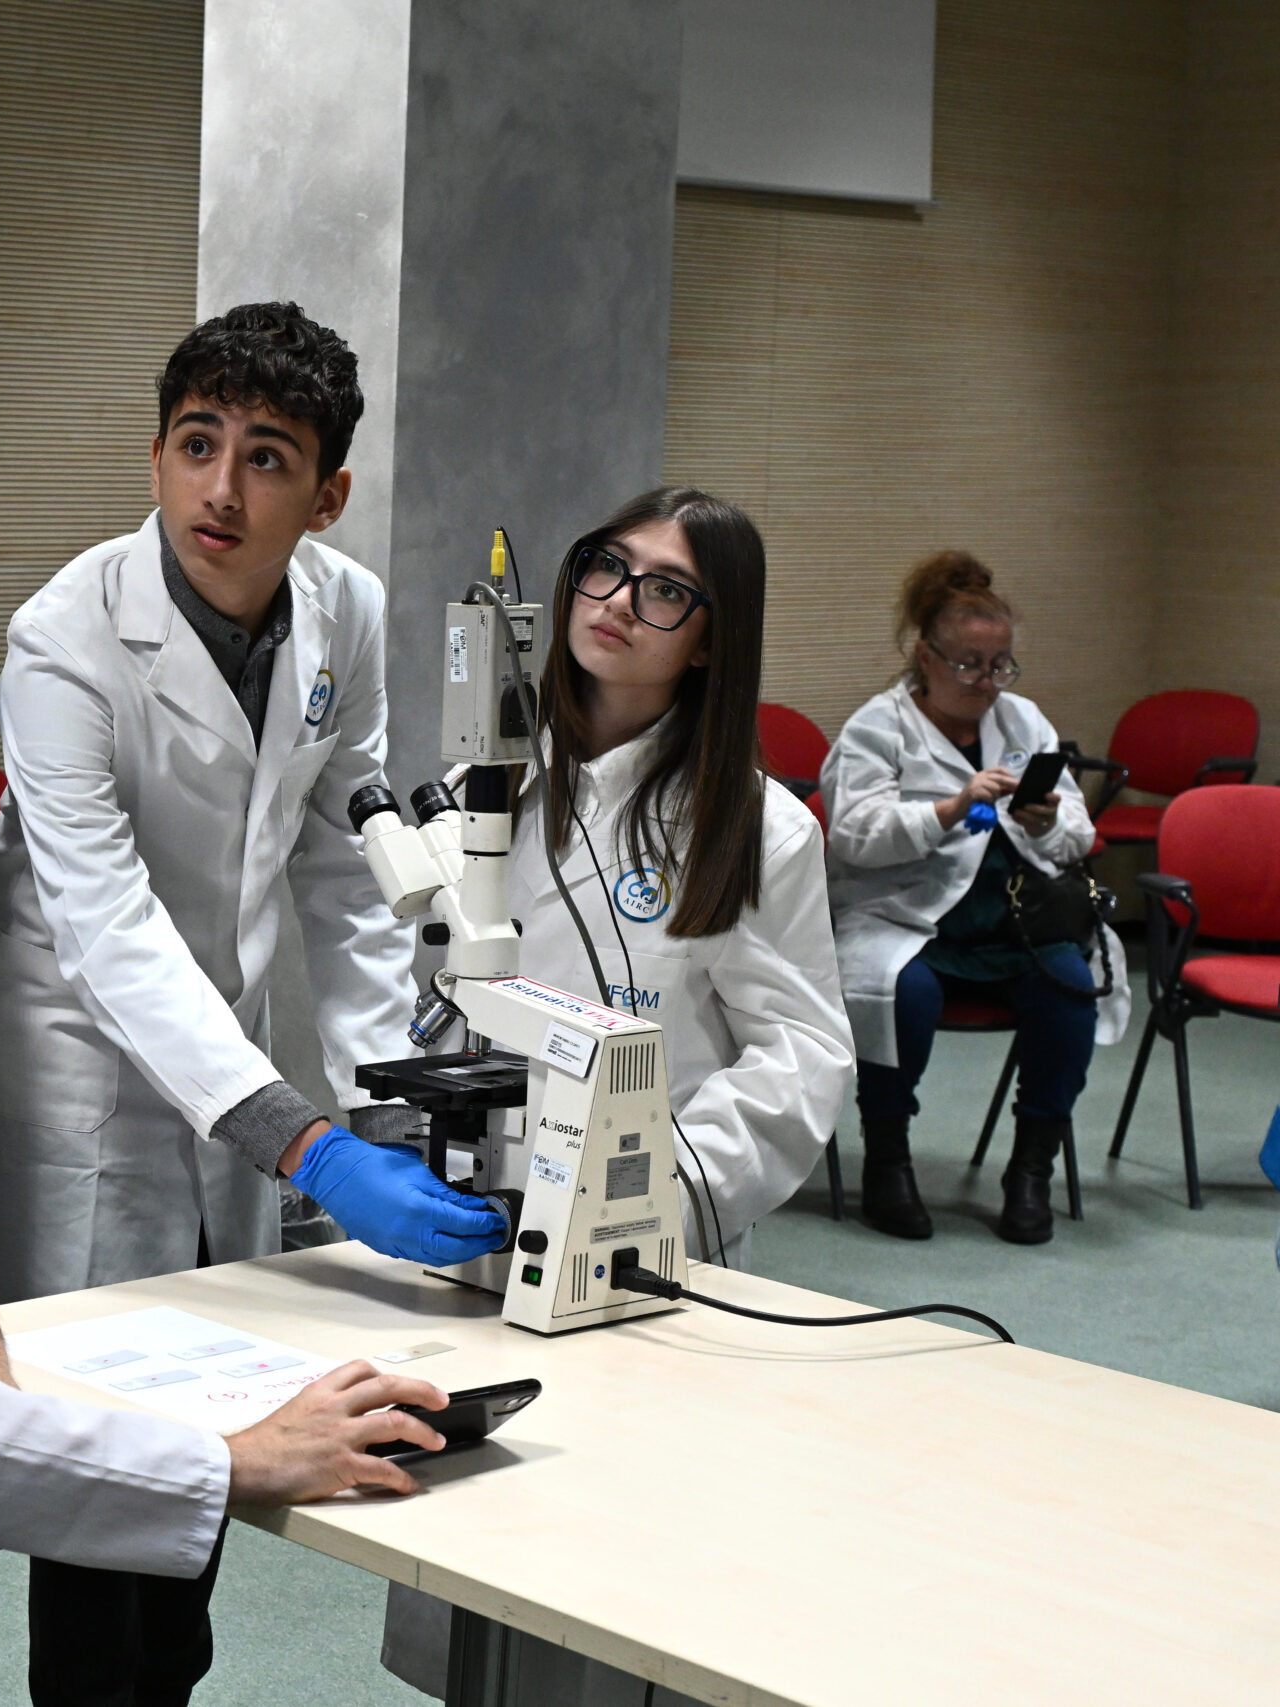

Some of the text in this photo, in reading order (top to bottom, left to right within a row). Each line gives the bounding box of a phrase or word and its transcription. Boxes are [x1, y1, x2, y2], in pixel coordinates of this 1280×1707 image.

[624, 897, 650, 913] AIRC
[540, 1117, 584, 1137] Axiostar
[566, 1140, 581, 1150] plus
